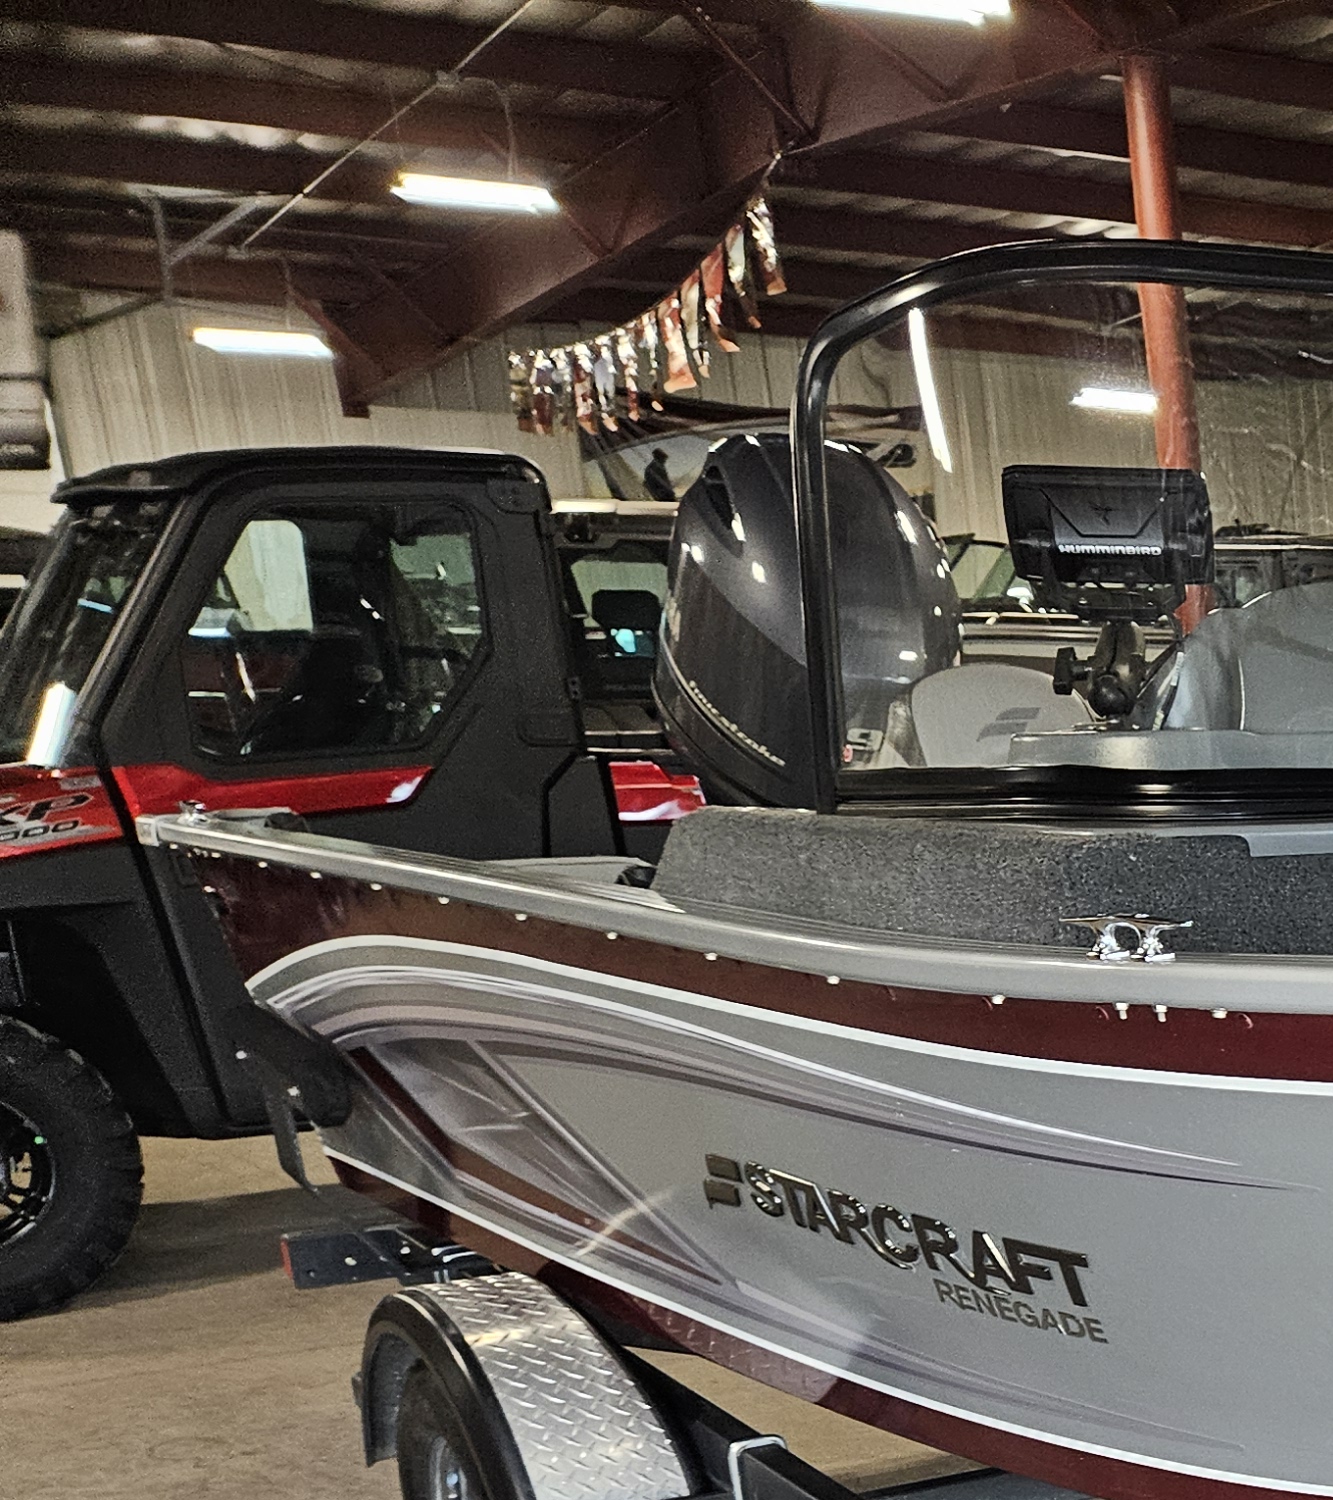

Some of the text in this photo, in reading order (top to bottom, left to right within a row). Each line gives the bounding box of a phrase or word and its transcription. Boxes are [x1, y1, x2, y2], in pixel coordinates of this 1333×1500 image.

[1058, 544, 1163, 556] HUMMINBIRD
[744, 1160, 1091, 1308] STARCRAFT
[932, 1277, 1109, 1345] RENEGADE
